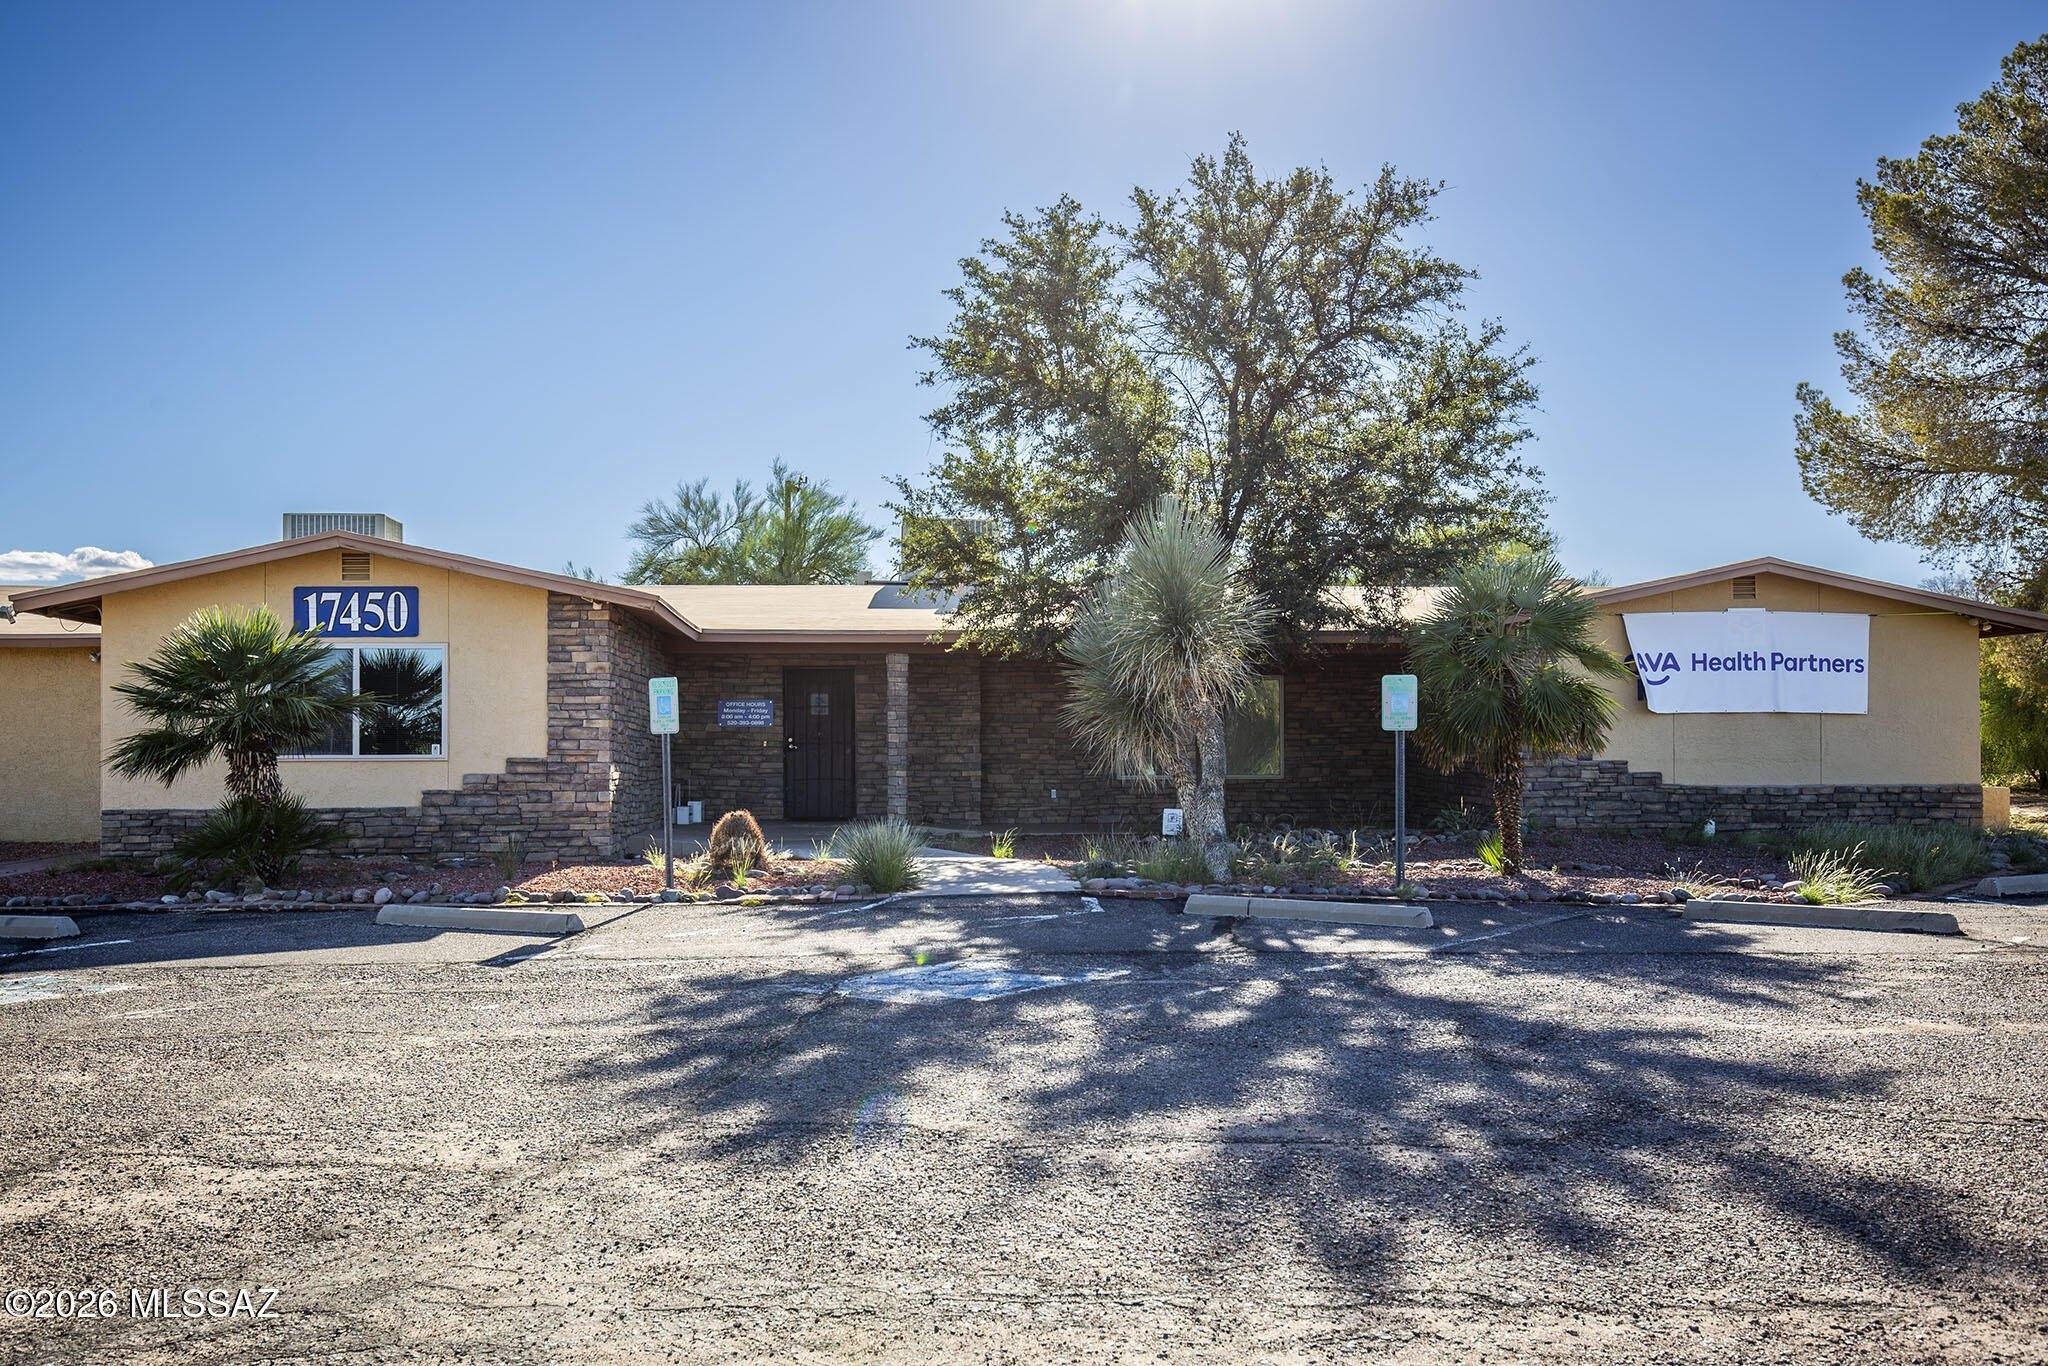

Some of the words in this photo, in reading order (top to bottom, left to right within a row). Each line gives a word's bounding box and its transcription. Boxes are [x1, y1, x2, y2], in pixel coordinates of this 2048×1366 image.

[303, 591, 408, 632] 17450
[1691, 651, 1766, 672] Health
[1771, 652, 1865, 673] Partners
